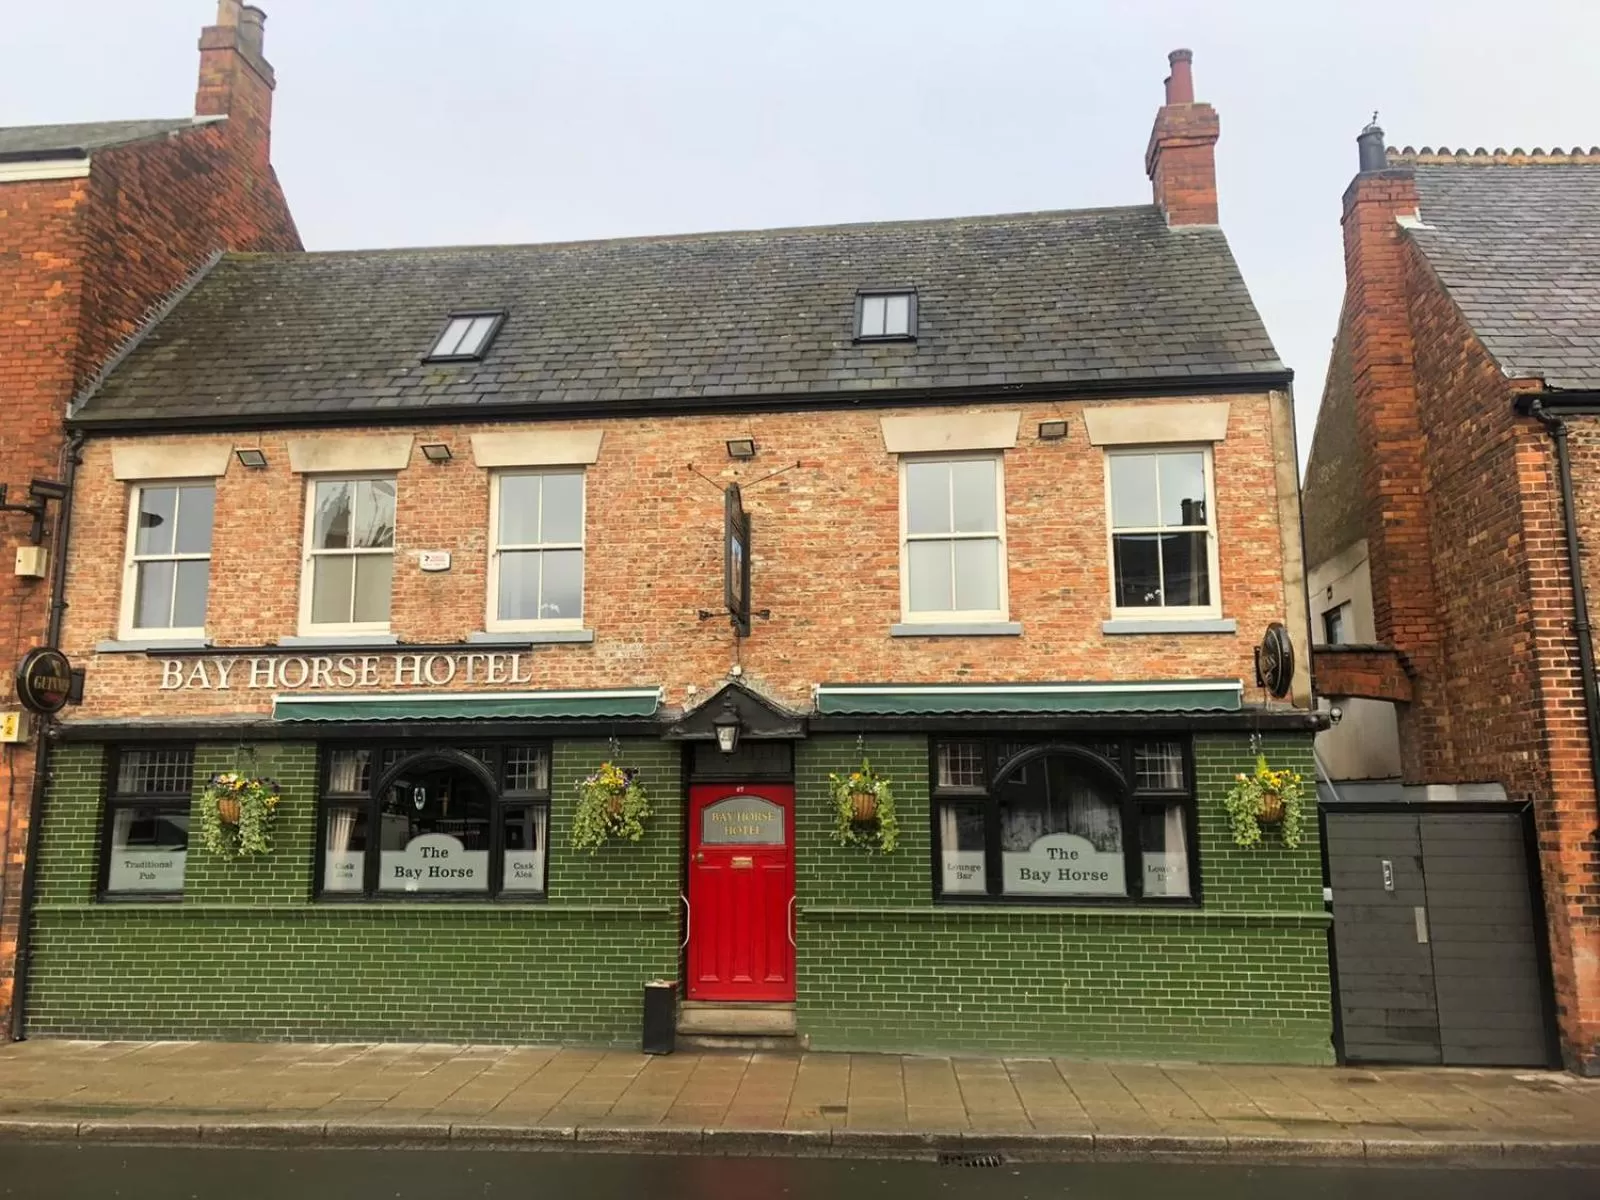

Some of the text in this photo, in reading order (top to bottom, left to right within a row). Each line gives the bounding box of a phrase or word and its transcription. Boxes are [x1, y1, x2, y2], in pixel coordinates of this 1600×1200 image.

[159, 653, 533, 691] BAY HORSE HOTEL
[711, 811, 776, 822] BAY HORSE
[724, 825, 763, 836] HOTEL
[420, 846, 449, 859] The
[1046, 847, 1080, 860] The
[124, 860, 173, 869] Traditional
[513, 862, 535, 871] Cask
[139, 871, 156, 880] Pub
[394, 865, 474, 880] Bay Horse
[514, 871, 533, 879] Ales
[956, 871, 973, 880] Bar
[1019, 867, 1109, 884] Bay Horse
